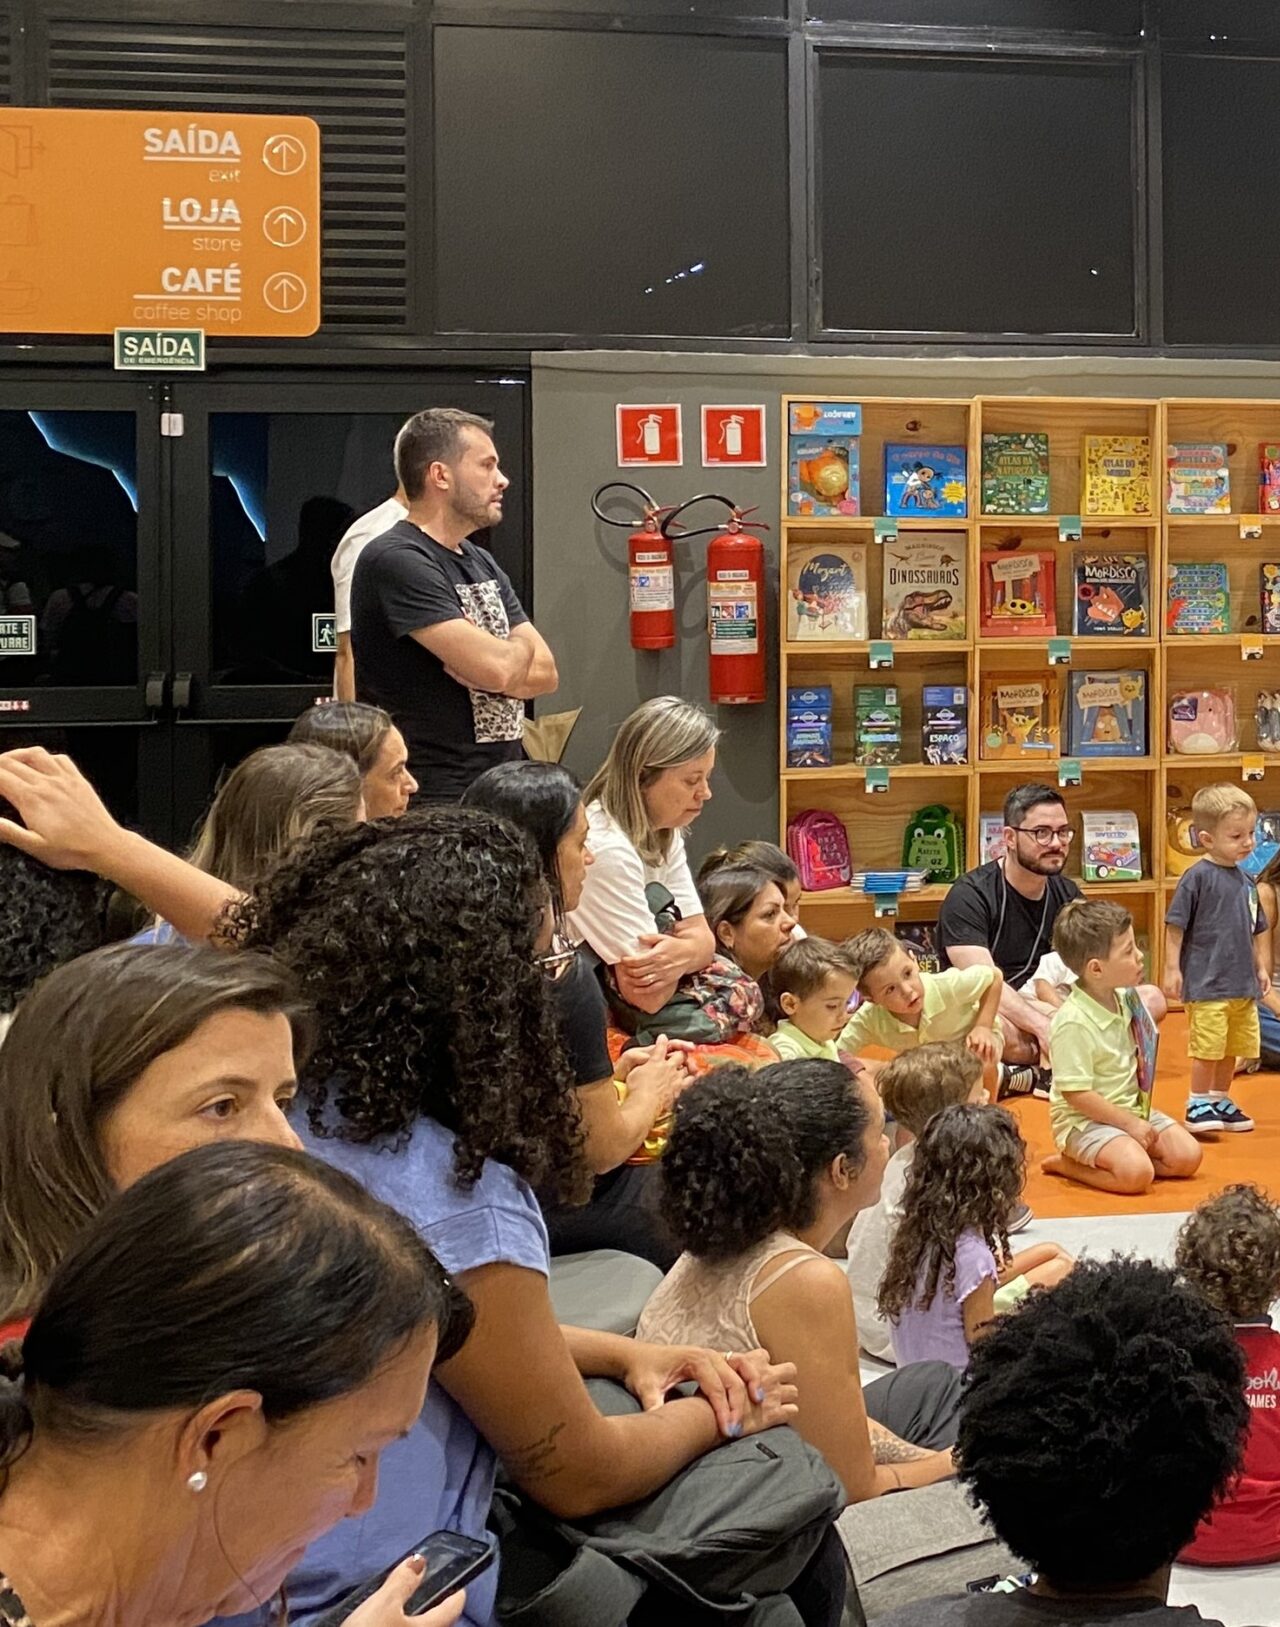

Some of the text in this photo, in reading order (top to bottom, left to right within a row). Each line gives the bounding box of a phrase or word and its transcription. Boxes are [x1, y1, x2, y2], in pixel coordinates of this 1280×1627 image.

[143, 123, 241, 155] SAÍDA
[209, 168, 240, 182] exit
[162, 197, 241, 223] LOJA
[192, 236, 242, 252] store
[161, 263, 241, 293] CAFÉ
[133, 304, 242, 324] coffee shop
[124, 332, 196, 356] SAÍDA
[803, 560, 849, 582] Mozart
